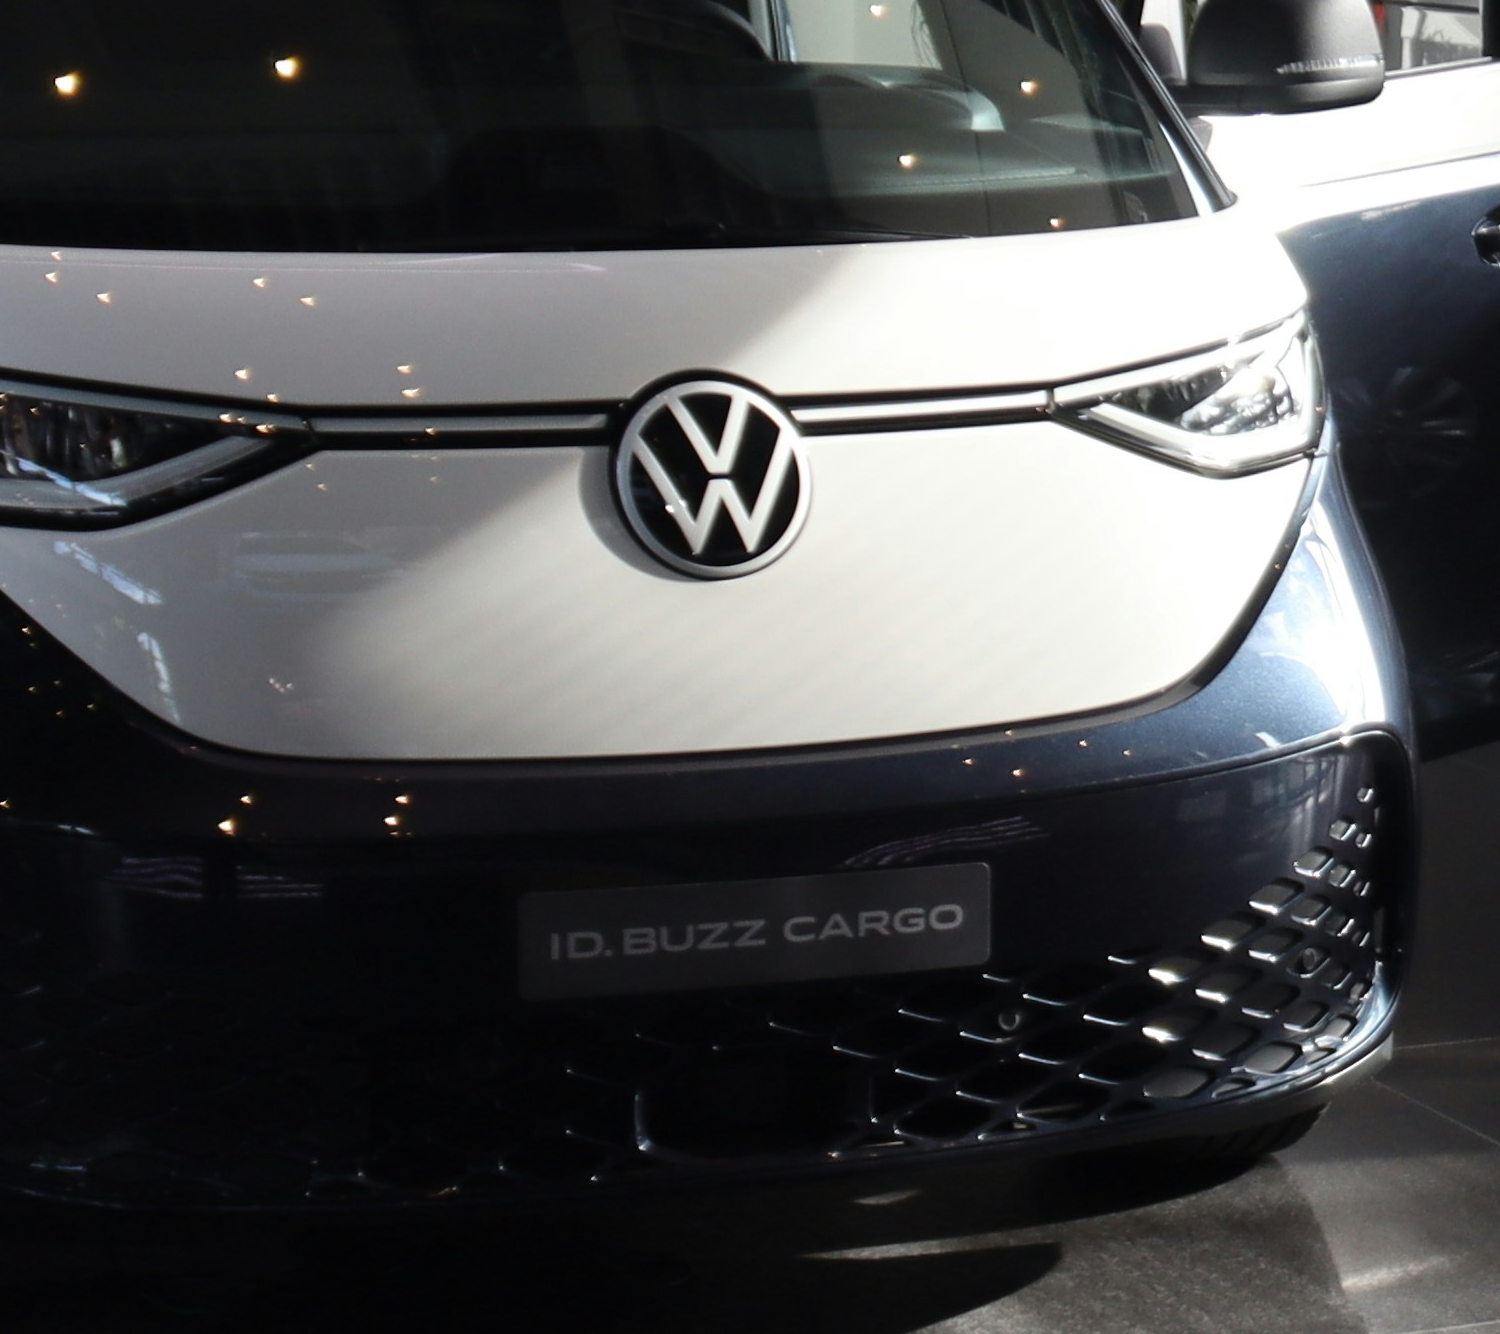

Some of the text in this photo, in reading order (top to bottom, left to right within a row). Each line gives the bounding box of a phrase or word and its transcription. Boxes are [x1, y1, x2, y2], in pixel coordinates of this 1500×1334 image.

[620, 385, 807, 571] VW
[549, 903, 965, 960] ID. BUZZ CARGO
